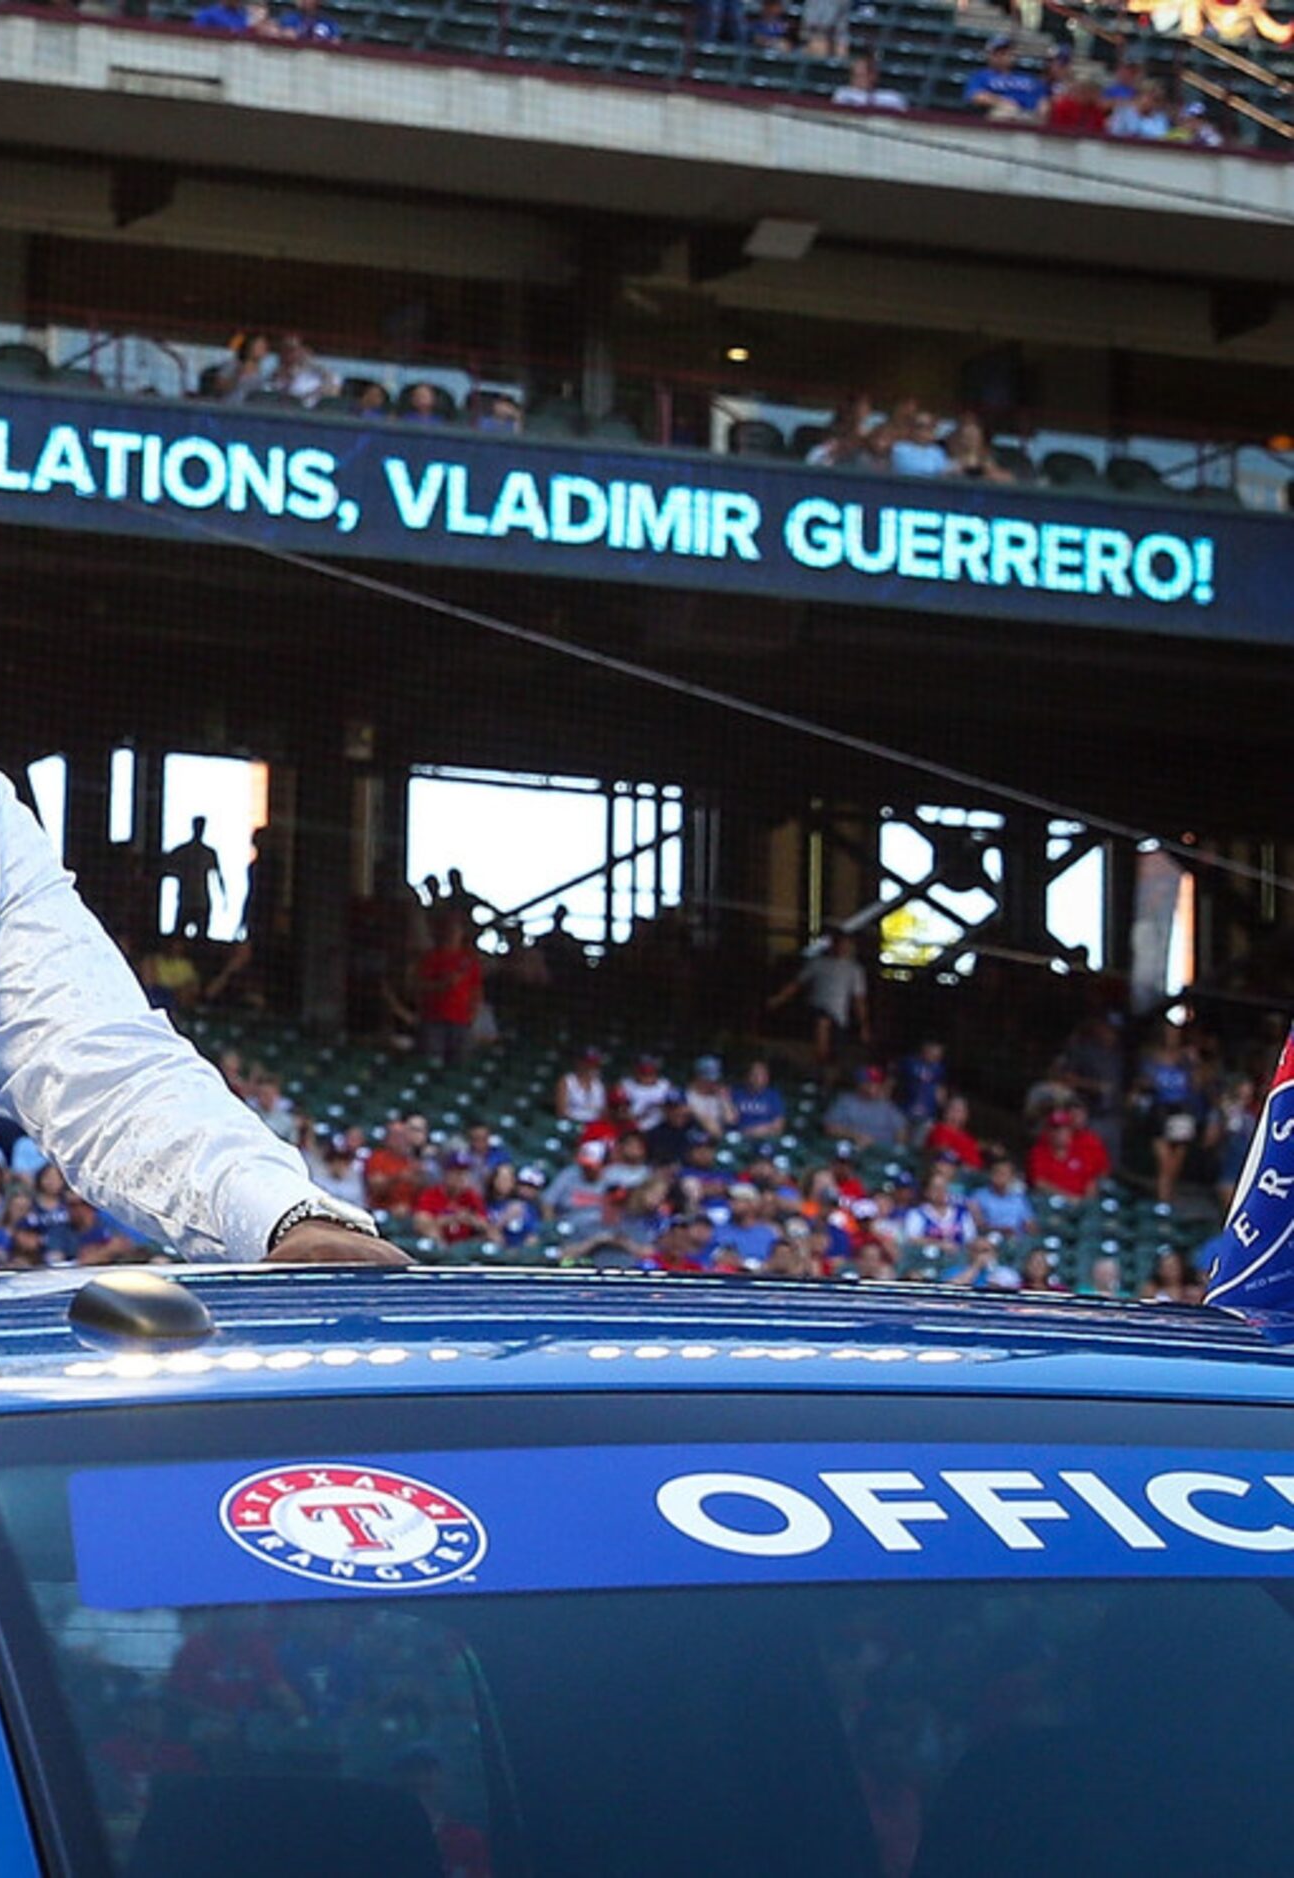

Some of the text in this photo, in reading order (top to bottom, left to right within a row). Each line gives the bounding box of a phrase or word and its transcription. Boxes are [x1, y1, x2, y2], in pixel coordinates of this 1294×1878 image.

[383, 456, 761, 561] VLADIMIR
[784, 497, 1215, 603] GUERRERO!
[244, 1471, 419, 1505] TEXAS
[655, 1470, 1294, 1557] OFFIC
[298, 1500, 394, 1551] T
[257, 1529, 470, 1581] RANGERS
